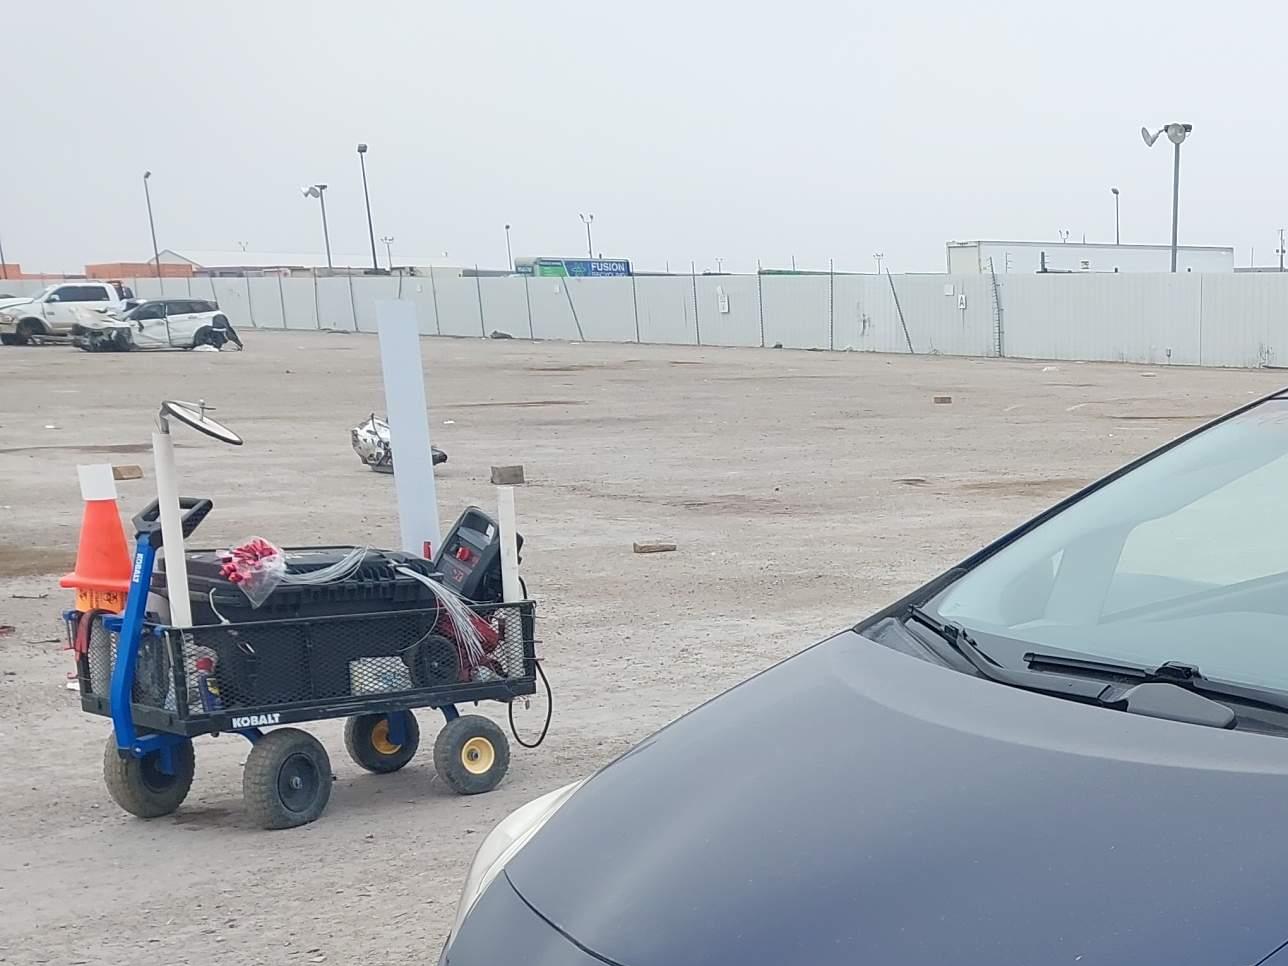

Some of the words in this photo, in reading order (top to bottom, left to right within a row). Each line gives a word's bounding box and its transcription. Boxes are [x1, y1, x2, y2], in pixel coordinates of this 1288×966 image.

[592, 262, 625, 272] FUSION
[132, 553, 144, 583] KOBALT
[232, 713, 281, 728] KOBALT
